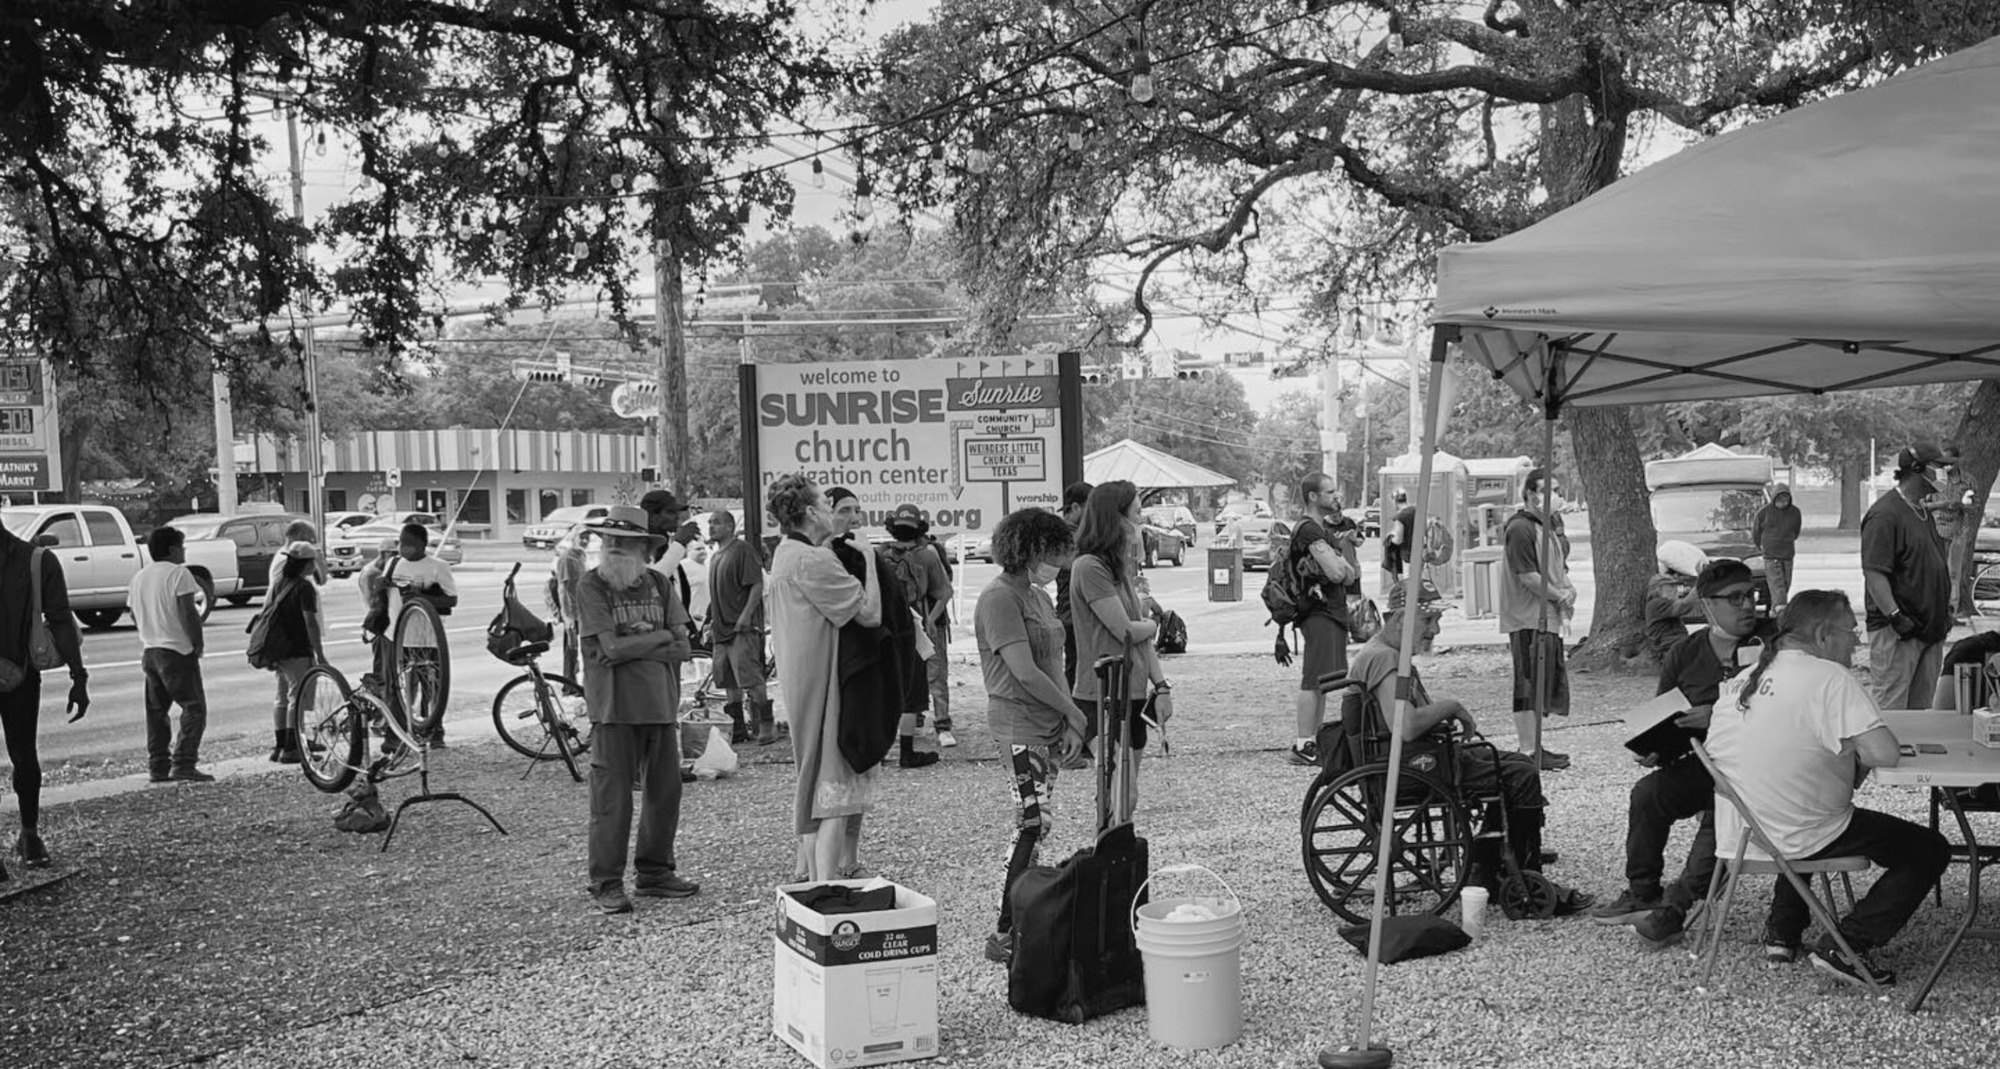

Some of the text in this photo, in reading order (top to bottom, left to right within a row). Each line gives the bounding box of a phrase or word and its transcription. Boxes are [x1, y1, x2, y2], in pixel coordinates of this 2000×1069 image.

[800, 368, 900, 385] welcome to
[958, 379, 1043, 407] Sunrise
[760, 389, 945, 427] SUNRISE
[977, 414, 1029, 424] COMMUNITY
[985, 424, 1021, 434] CHURCH
[0, 437, 28, 447] IESEL
[795, 428, 911, 463] church
[969, 442, 1040, 454] WEIRDEST LITTLE
[982, 455, 1026, 465] CHURCH IN
[763, 465, 949, 487] nigation center
[991, 466, 1018, 477] TEXAS
[894, 491, 949, 505] program
[1016, 492, 1059, 503] worship
[882, 939, 909, 949] CLEAR
[858, 944, 931, 960] COLD DRINK CUPS
